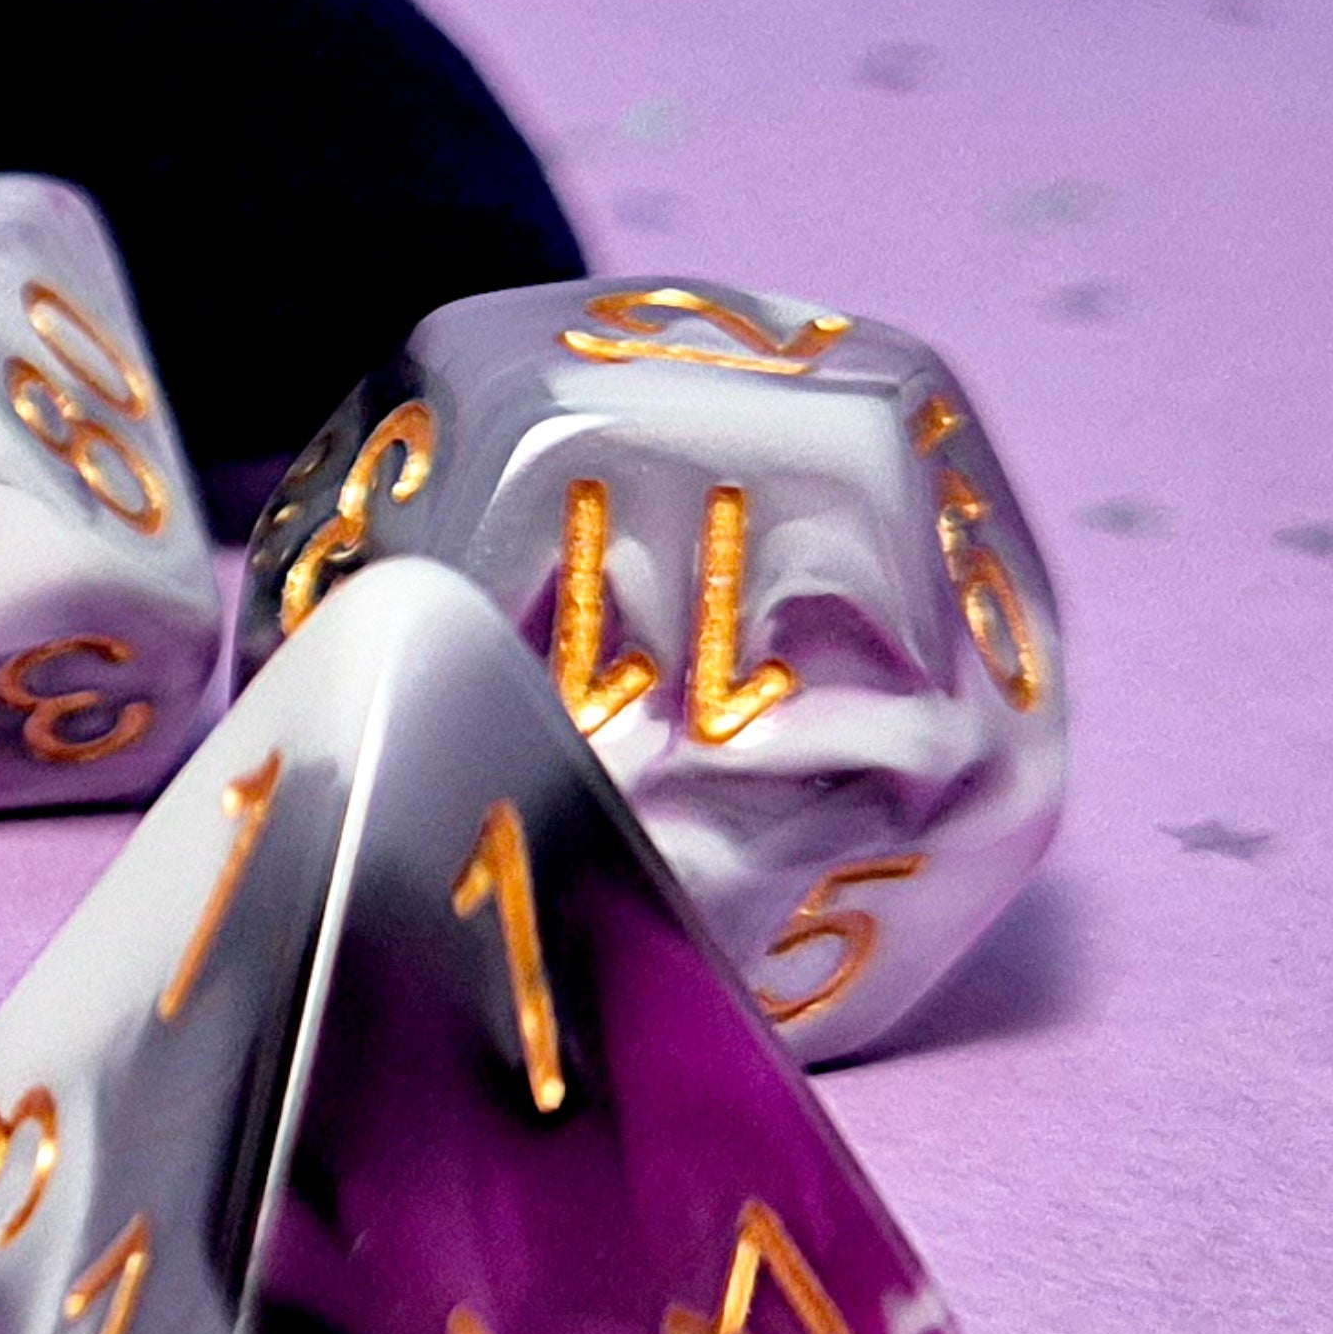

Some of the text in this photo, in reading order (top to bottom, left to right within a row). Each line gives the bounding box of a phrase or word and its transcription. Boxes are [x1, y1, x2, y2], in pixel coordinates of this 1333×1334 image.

[1, 277, 167, 537] 80
[550, 480, 799, 746] 11
[155, 749, 284, 1022] 1
[449, 799, 567, 1113] 1
[757, 850, 932, 1025] 5
